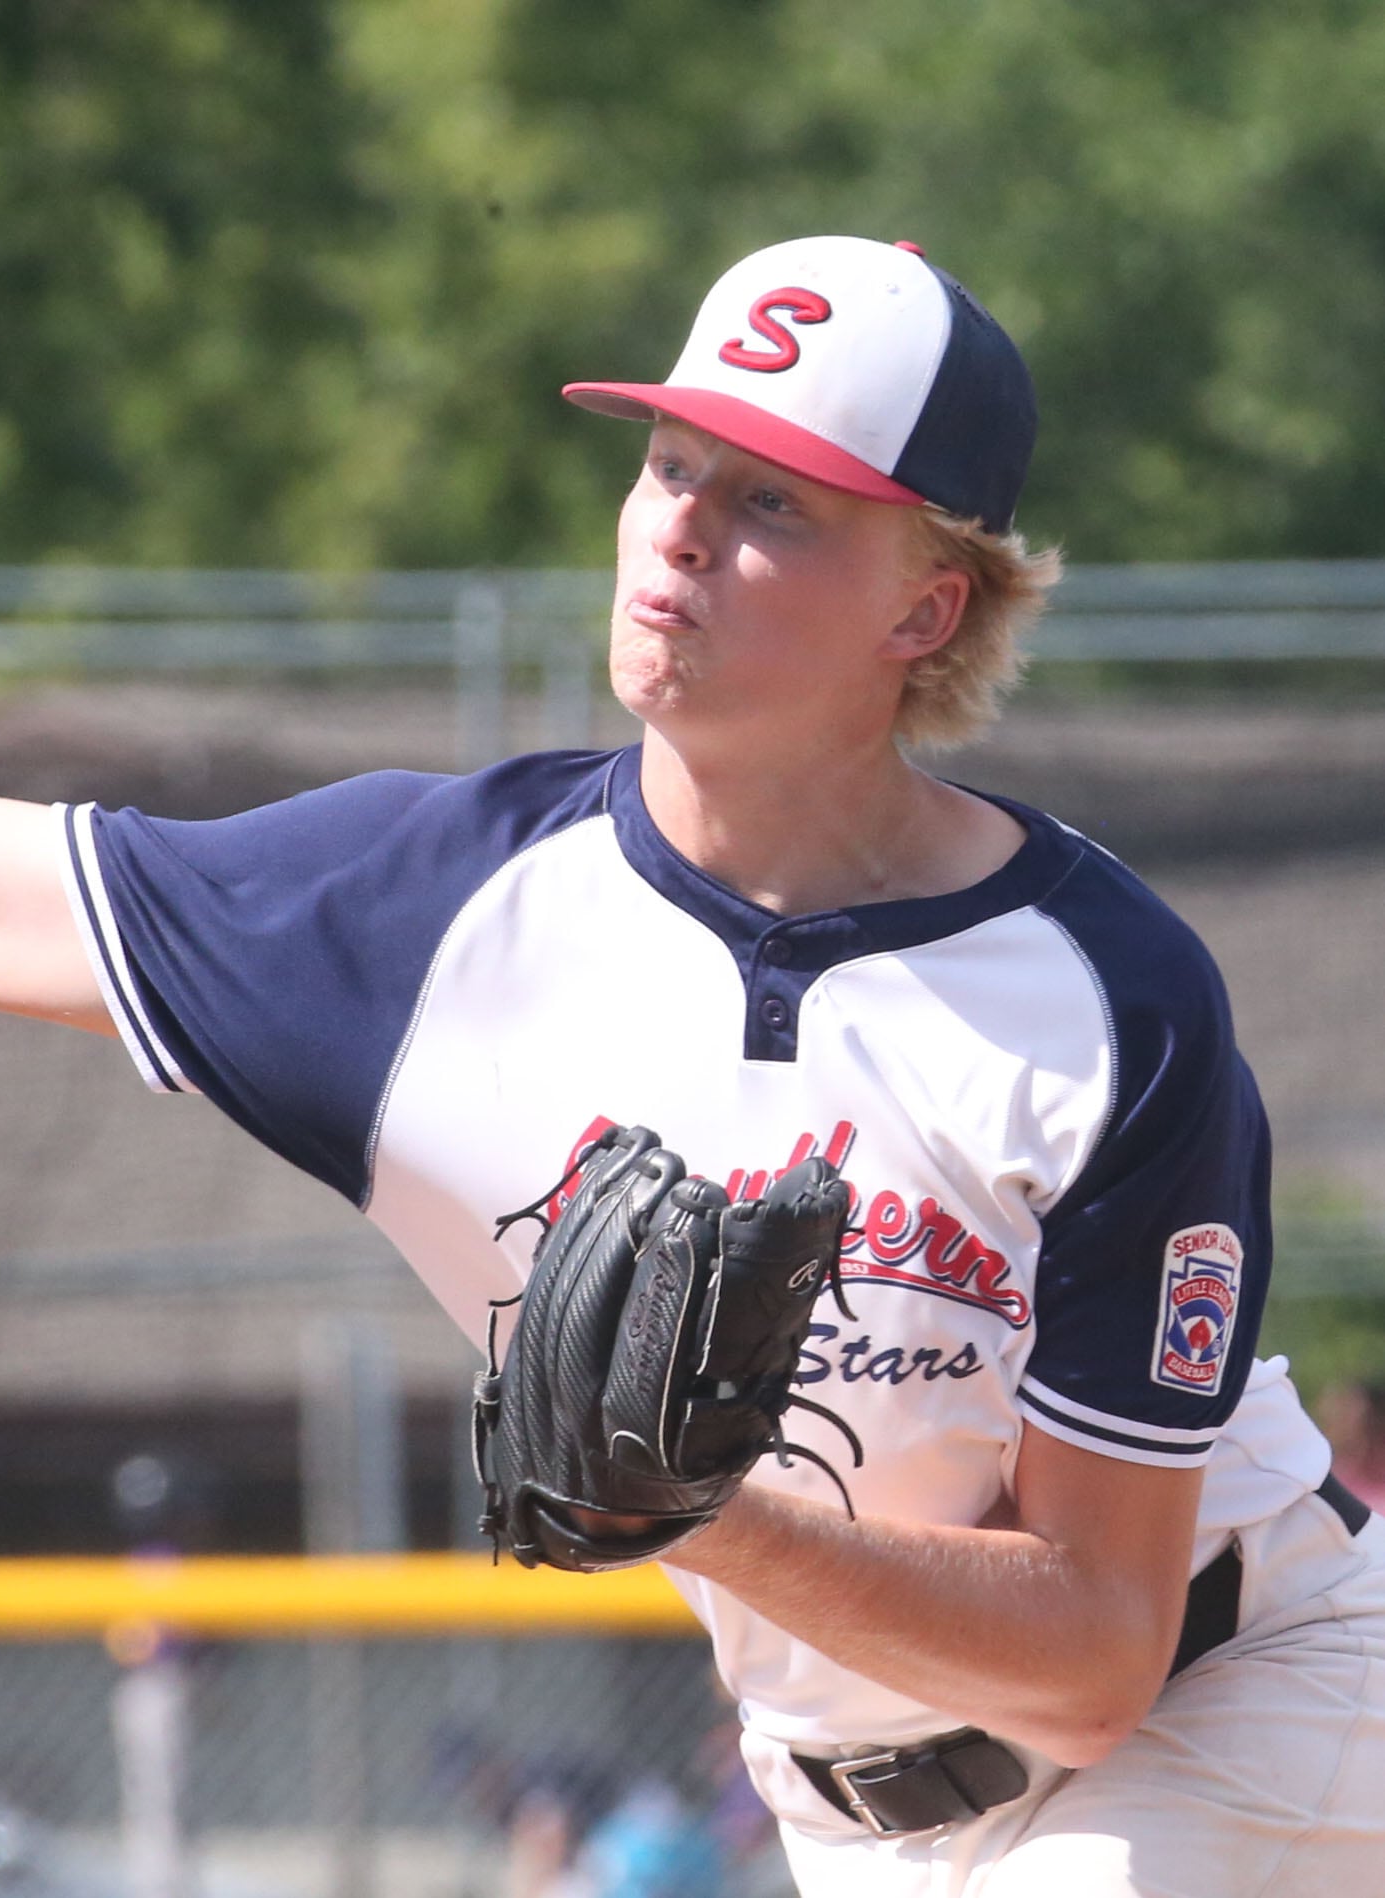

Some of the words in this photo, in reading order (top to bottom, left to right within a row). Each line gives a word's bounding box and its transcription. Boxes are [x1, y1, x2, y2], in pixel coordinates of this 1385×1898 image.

[719, 286, 832, 373] S
[1173, 1229, 1218, 1258] SENIOR
[1220, 1232, 1240, 1266] LEA
[1175, 1280, 1208, 1303] LITTLE
[1208, 1280, 1232, 1314] LEA
[792, 1322, 984, 1385] Stars
[1168, 1356, 1214, 1378] BASEBALL
